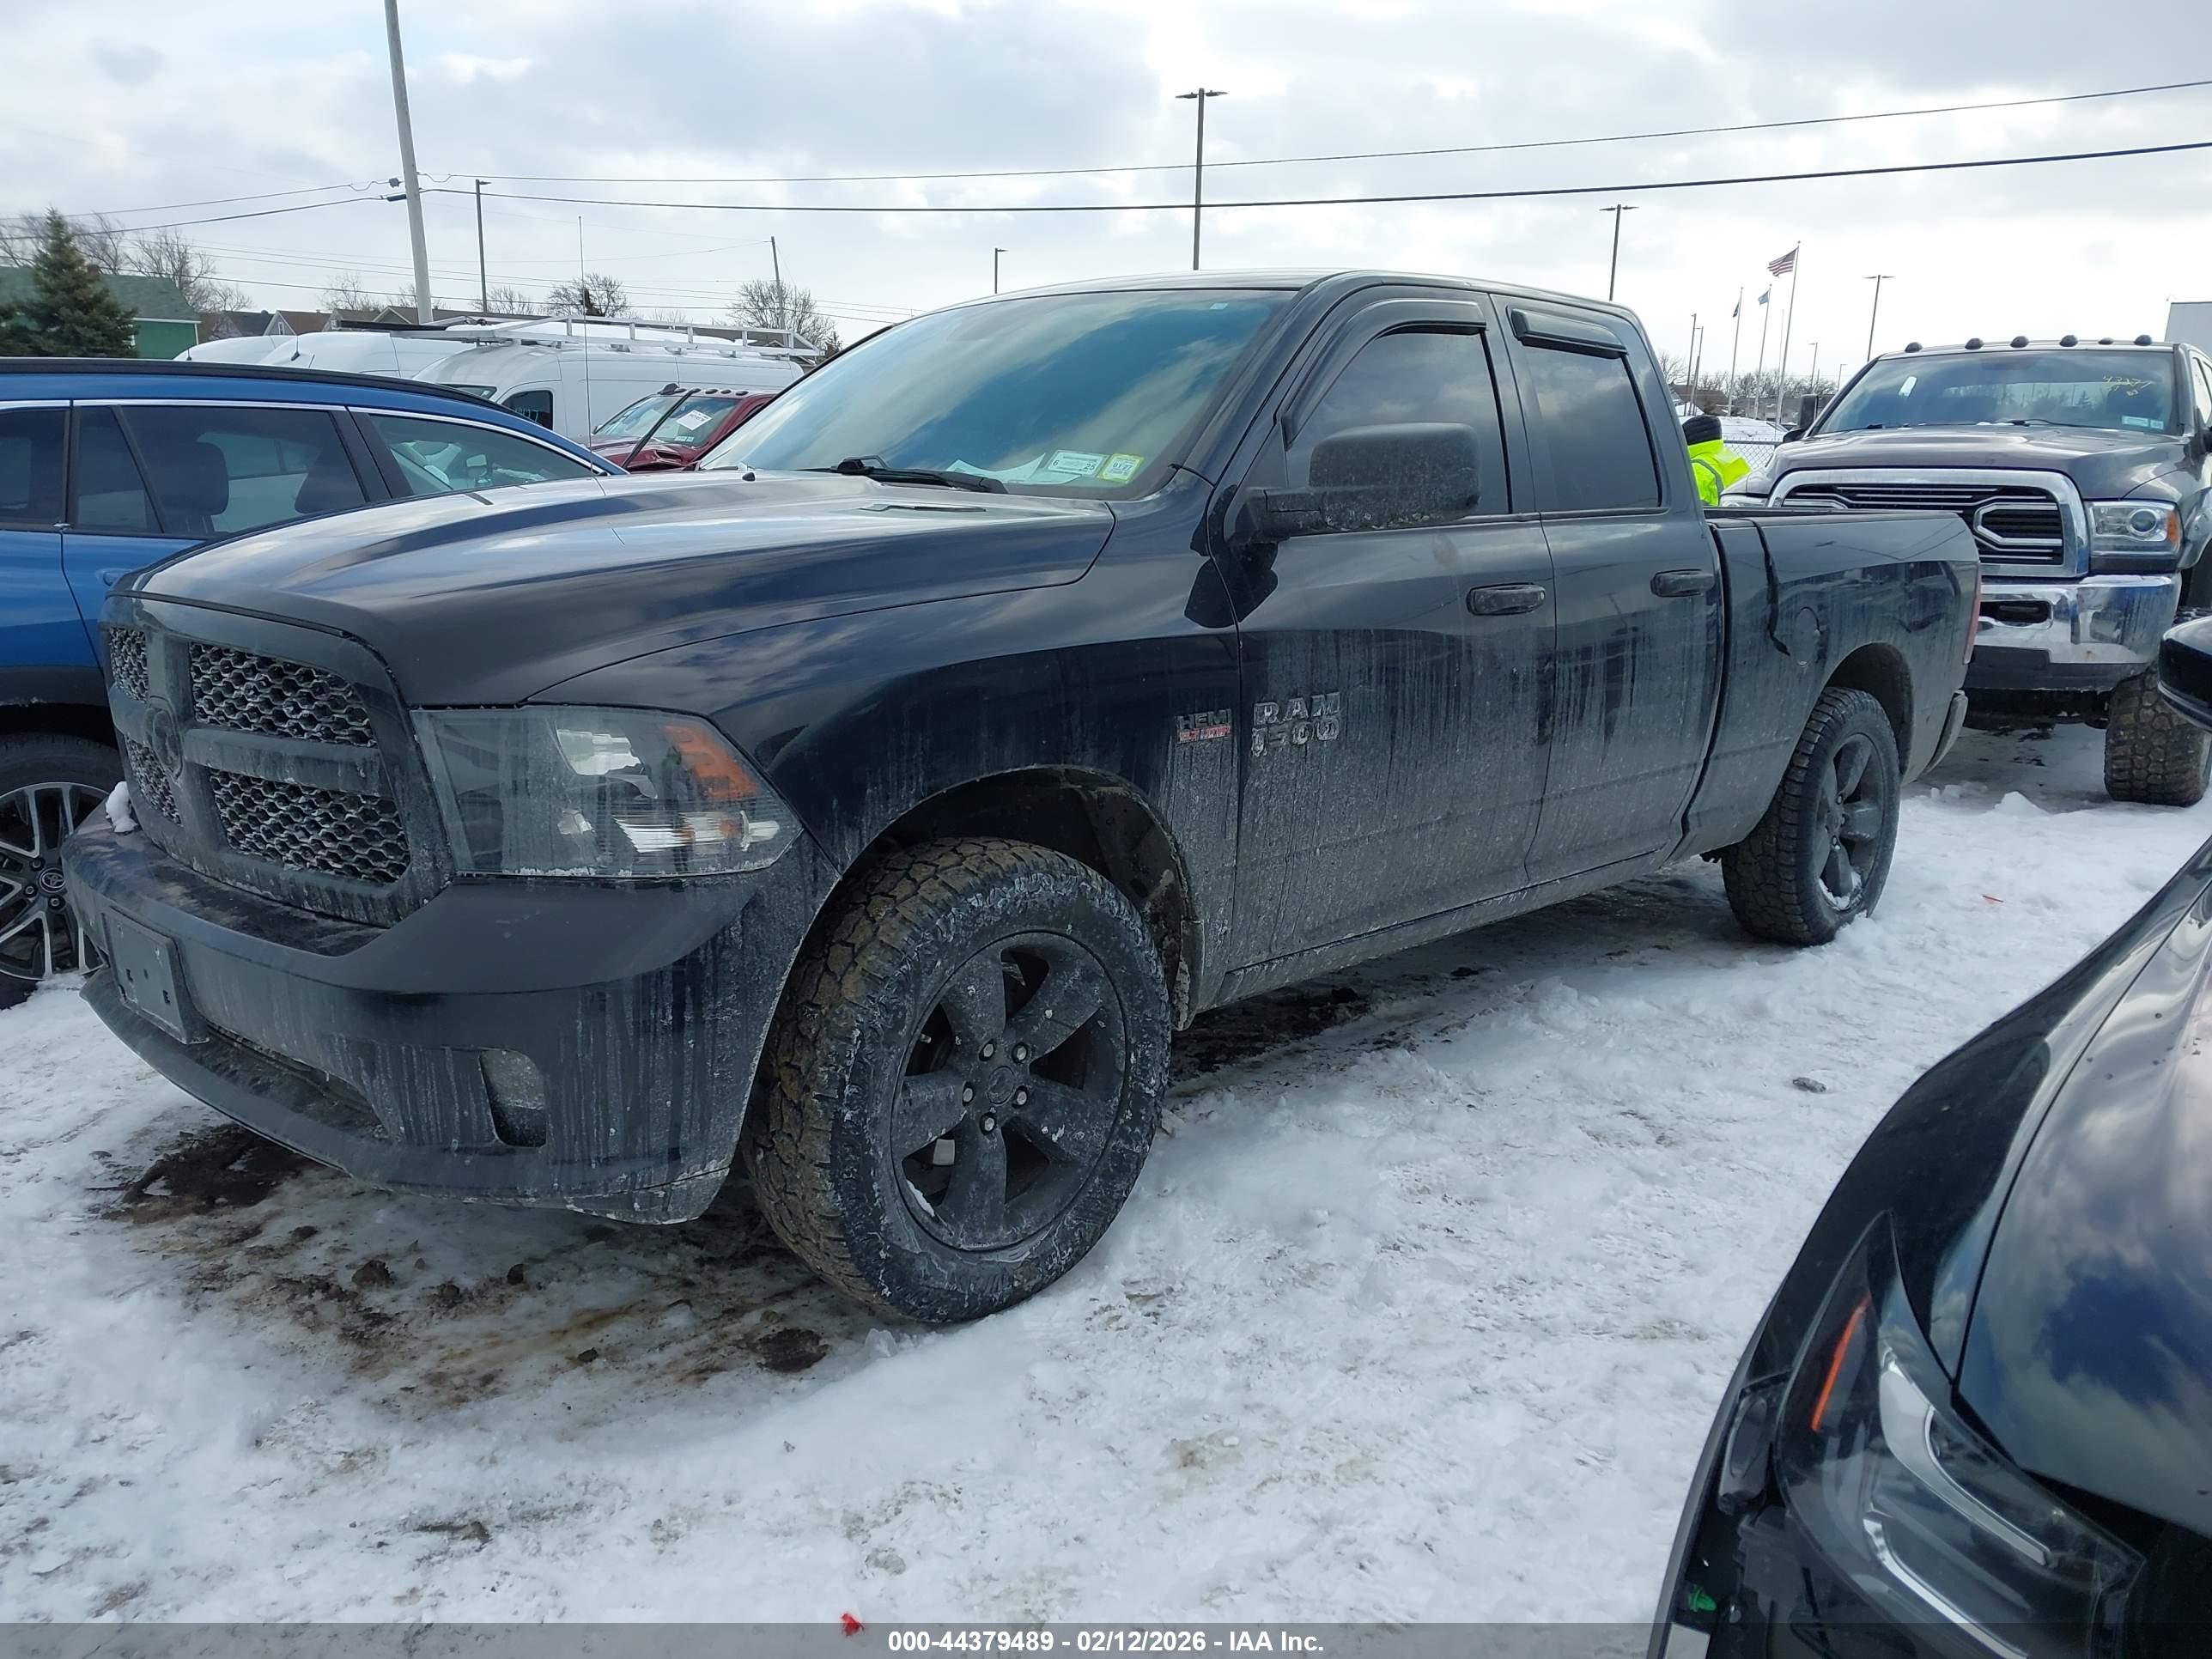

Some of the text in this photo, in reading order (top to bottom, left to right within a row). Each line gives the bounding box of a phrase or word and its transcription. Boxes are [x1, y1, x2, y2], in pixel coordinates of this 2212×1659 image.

[1176, 708, 1231, 729] HEMI
[1254, 692, 1340, 725] RAM
[1251, 717, 1340, 757] 1500
